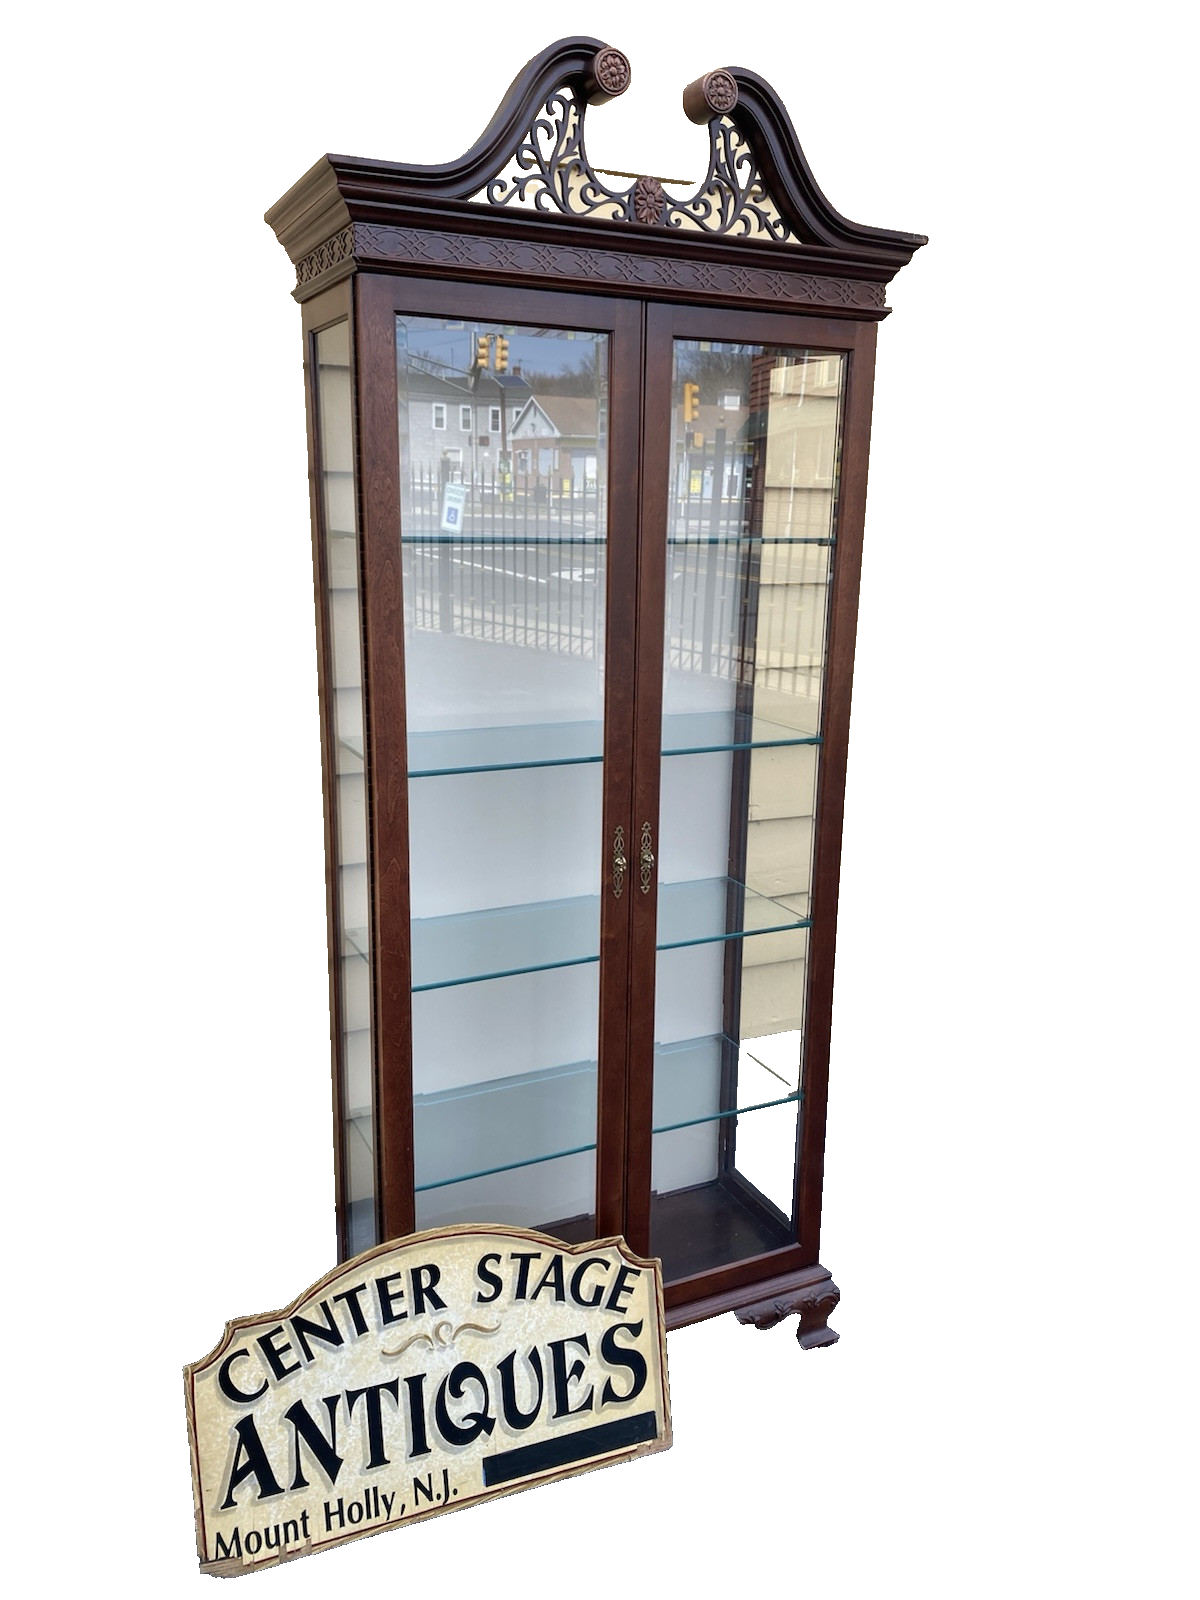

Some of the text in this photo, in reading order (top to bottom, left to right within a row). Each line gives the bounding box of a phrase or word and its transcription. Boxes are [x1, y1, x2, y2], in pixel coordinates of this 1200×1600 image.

[218, 1252, 642, 1404] CENTER STAGE
[220, 1318, 648, 1510] ANTIQUES
[213, 1468, 459, 1561] Mount Holly, N.J.
